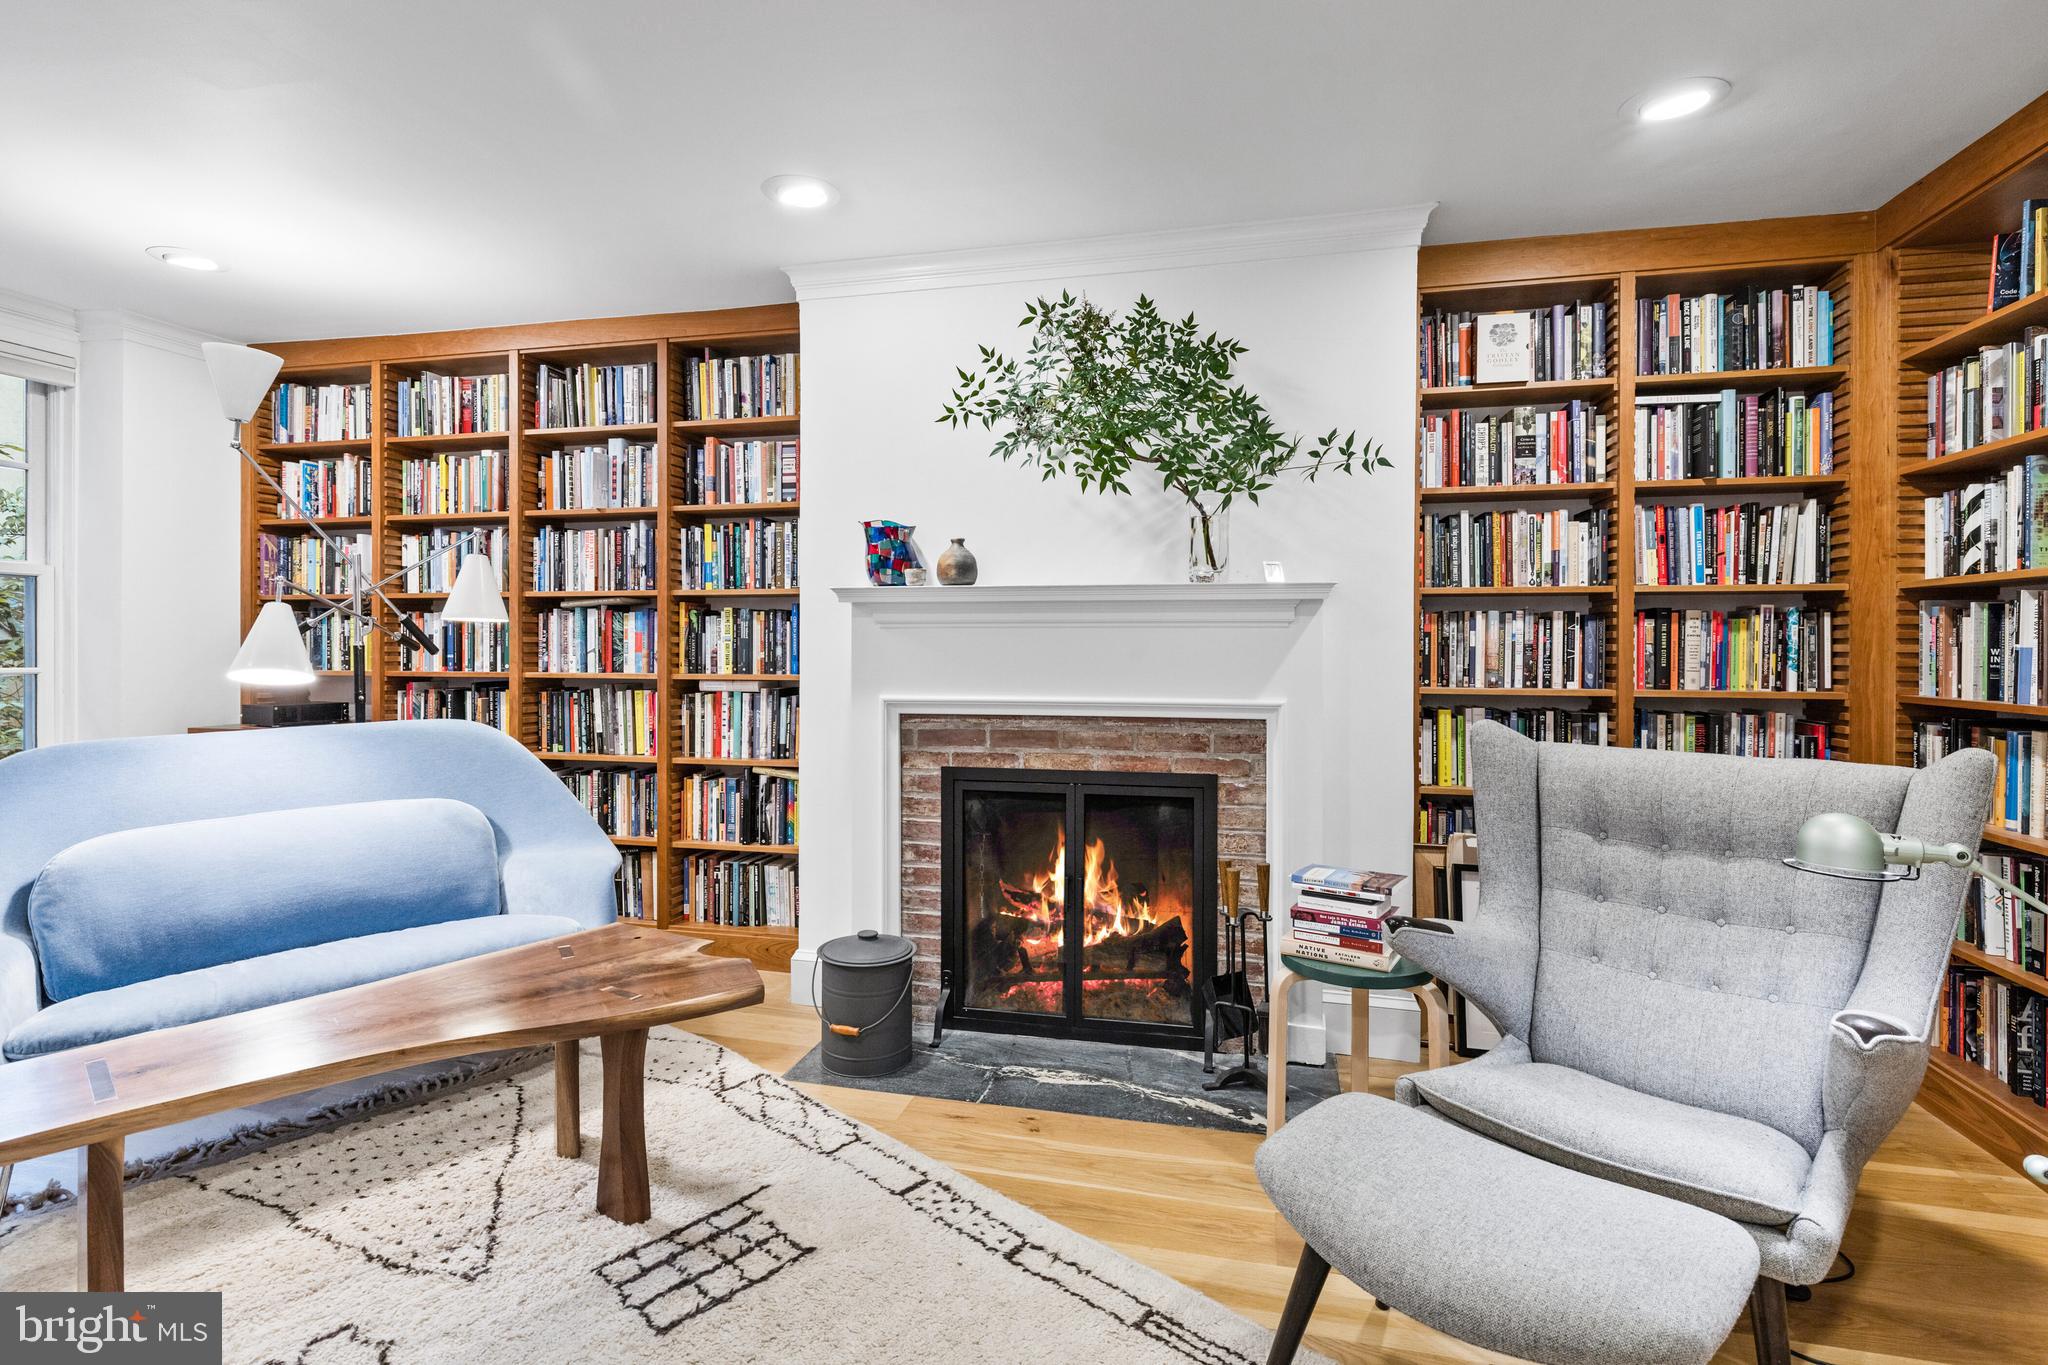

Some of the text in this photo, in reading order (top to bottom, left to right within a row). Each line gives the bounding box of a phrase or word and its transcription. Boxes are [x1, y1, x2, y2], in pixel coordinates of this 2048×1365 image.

[1684, 316, 1690, 325] ON
[1298, 944, 1326, 953] NATIVE
[1296, 949, 1329, 960] NATIONS
[1335, 952, 1361, 960] KATHLEEN
